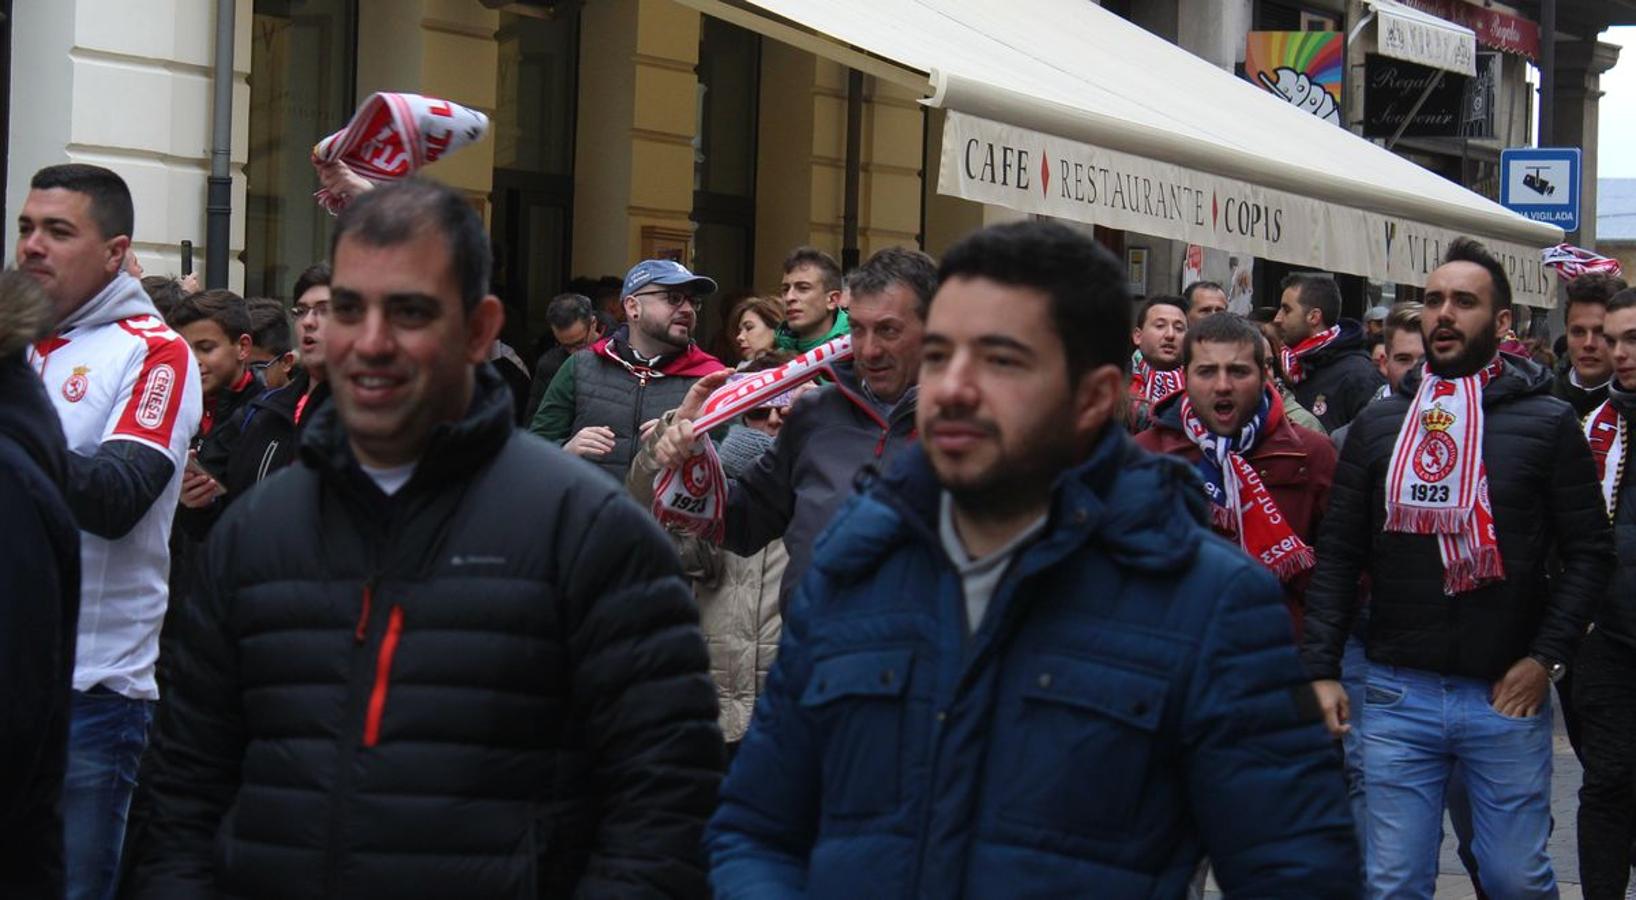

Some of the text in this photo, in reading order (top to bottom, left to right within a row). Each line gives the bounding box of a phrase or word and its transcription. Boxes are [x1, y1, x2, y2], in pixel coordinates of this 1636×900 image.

[1372, 66, 1446, 96] Regals
[1371, 102, 1452, 125] Souenir
[964, 138, 1030, 190] CAFE
[1224, 197, 1283, 244] COPIS
[1530, 211, 1574, 221] VIGILADA
[1410, 483, 1450, 502] 1923
